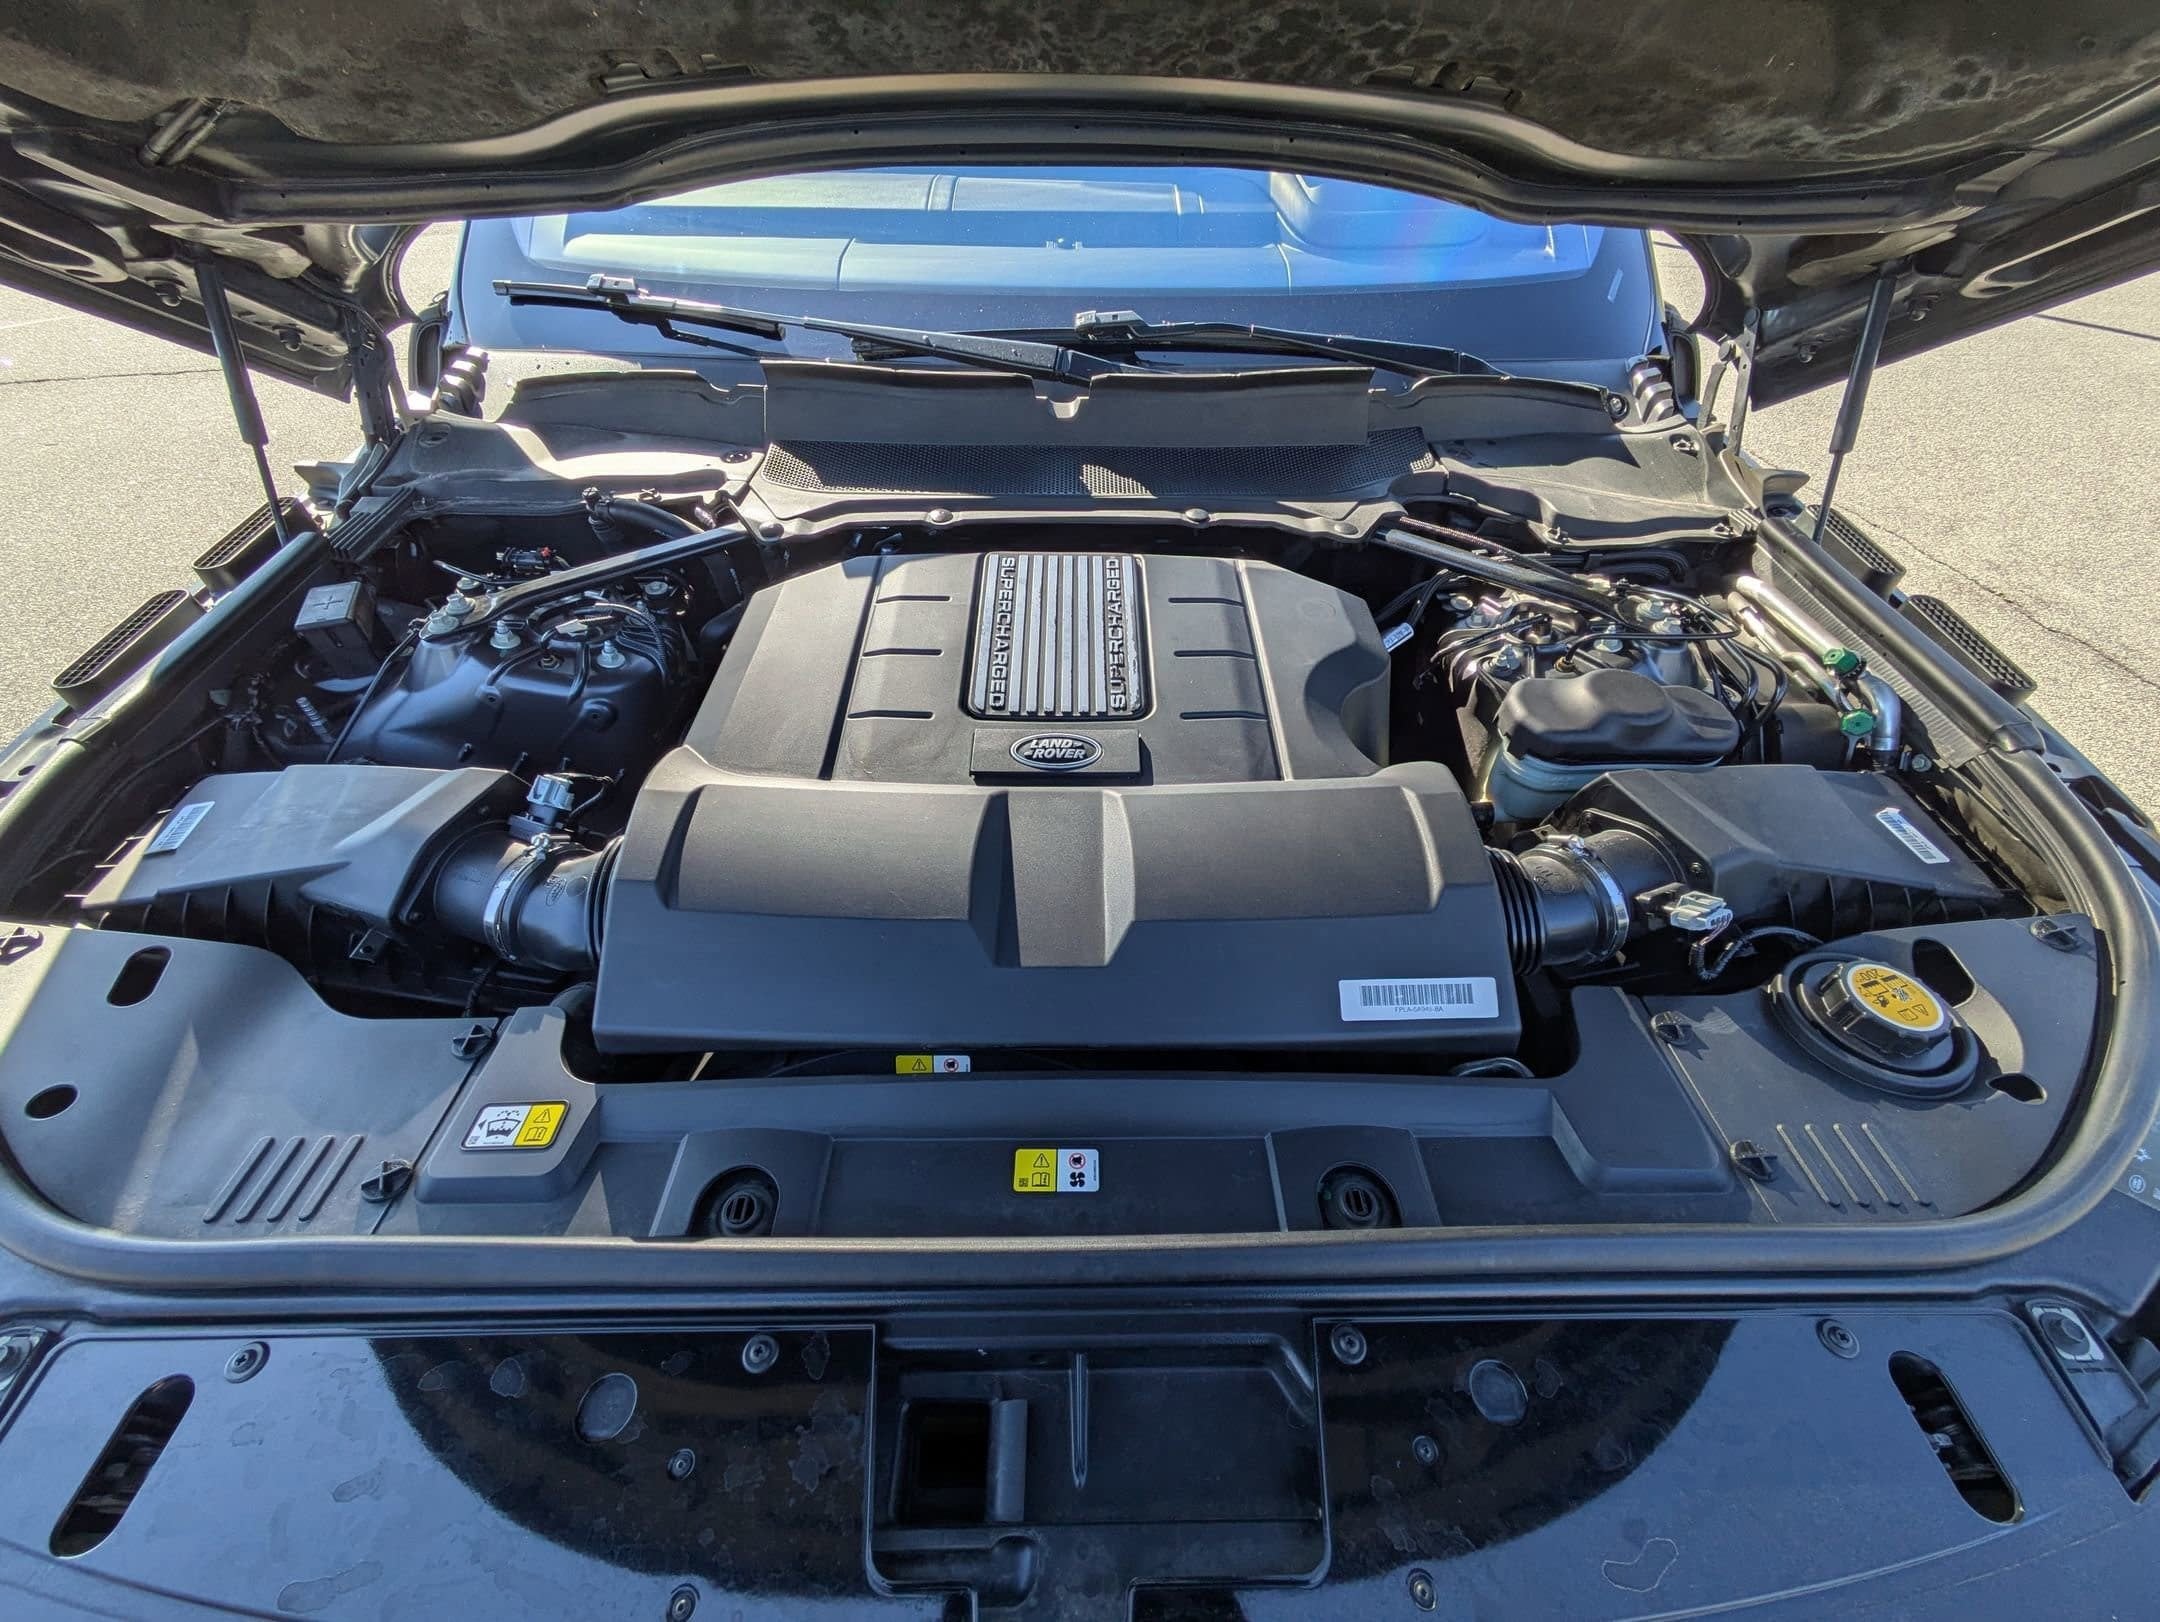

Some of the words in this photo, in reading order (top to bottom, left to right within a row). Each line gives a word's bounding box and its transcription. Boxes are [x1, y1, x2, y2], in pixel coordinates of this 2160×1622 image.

[988, 556, 1016, 711] SUPERCHARGED
[1106, 557, 1128, 712] SUPERCHARGED
[1030, 738, 1073, 749] LAND
[1032, 748, 1086, 759] ROVER
